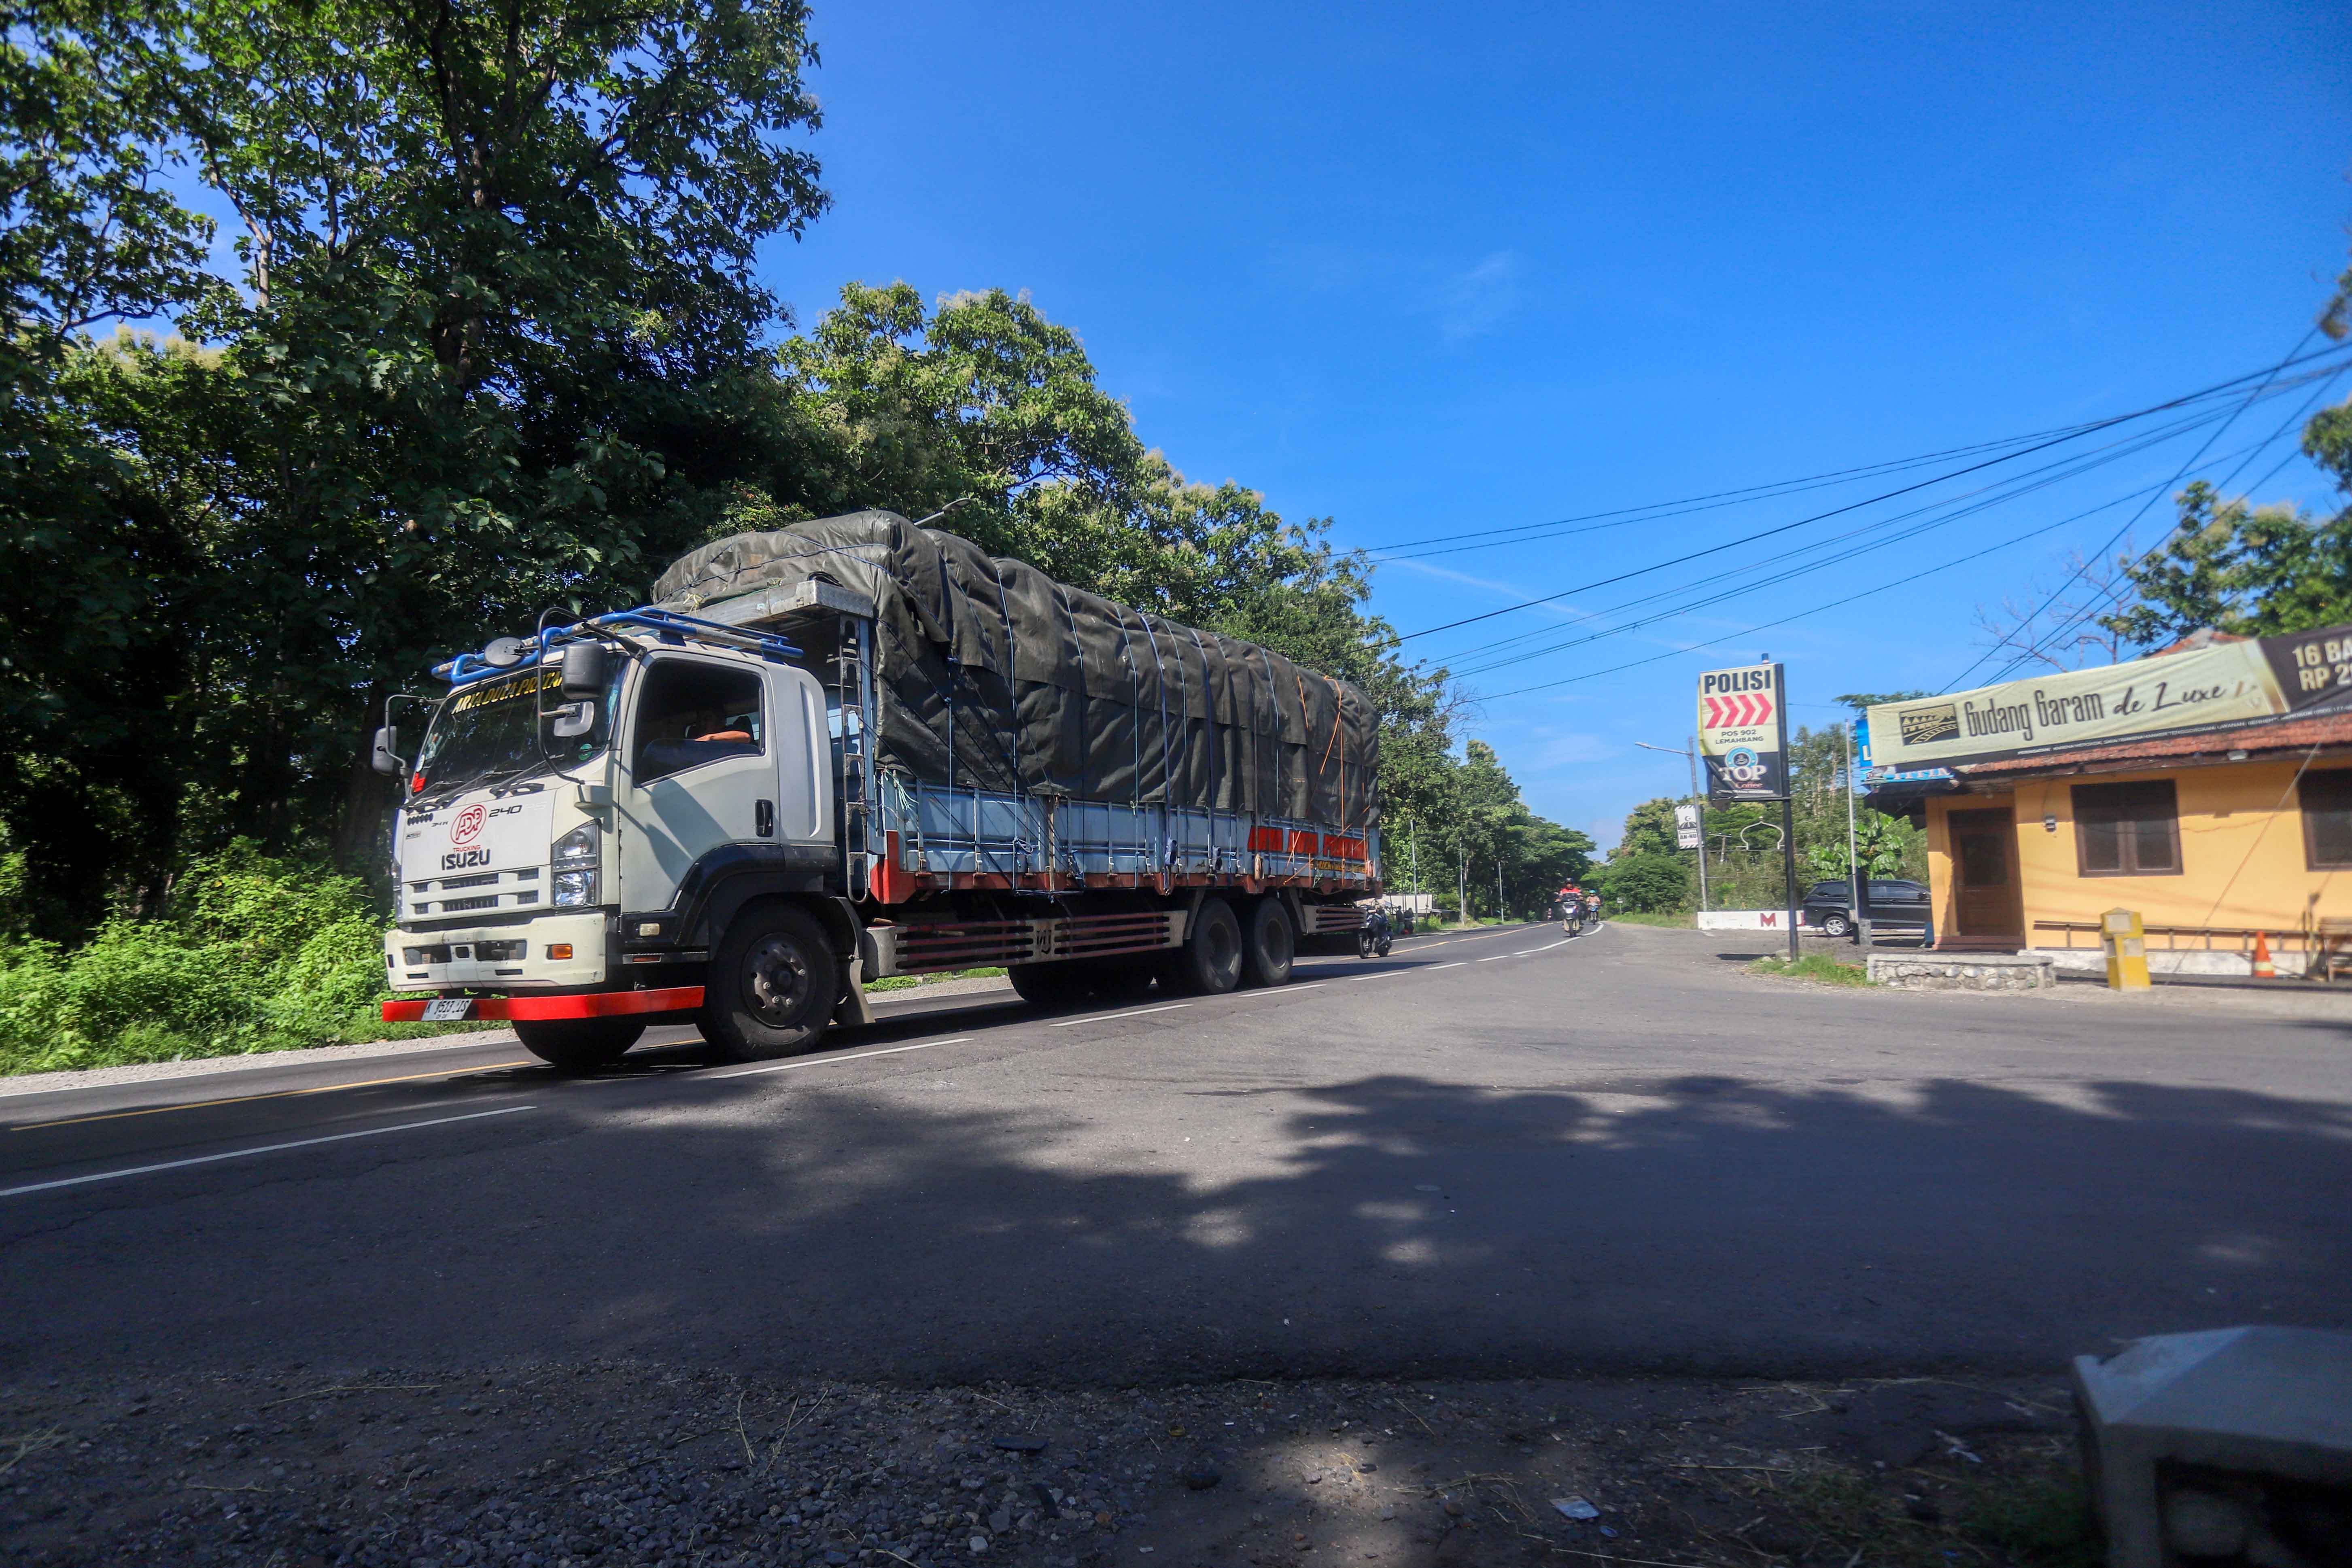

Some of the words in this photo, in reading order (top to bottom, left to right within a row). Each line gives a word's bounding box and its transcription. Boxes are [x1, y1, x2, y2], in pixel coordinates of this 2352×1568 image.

[2292, 643, 2322, 667] 16
[1704, 670, 1771, 694] POLISI
[2299, 667, 2331, 691] RP
[2335, 663, 2352, 685] 2
[1964, 698, 2033, 741] Gudang
[2035, 690, 2104, 727] Garam
[2113, 687, 2145, 715] de
[2151, 681, 2225, 711] Luxe
[1715, 736, 1764, 744] LEMAHBANG
[1719, 764, 1767, 781] TOP
[489, 804, 522, 818] 240
[453, 844, 481, 853] TRUCKING
[442, 849, 491, 870] ISUZU
